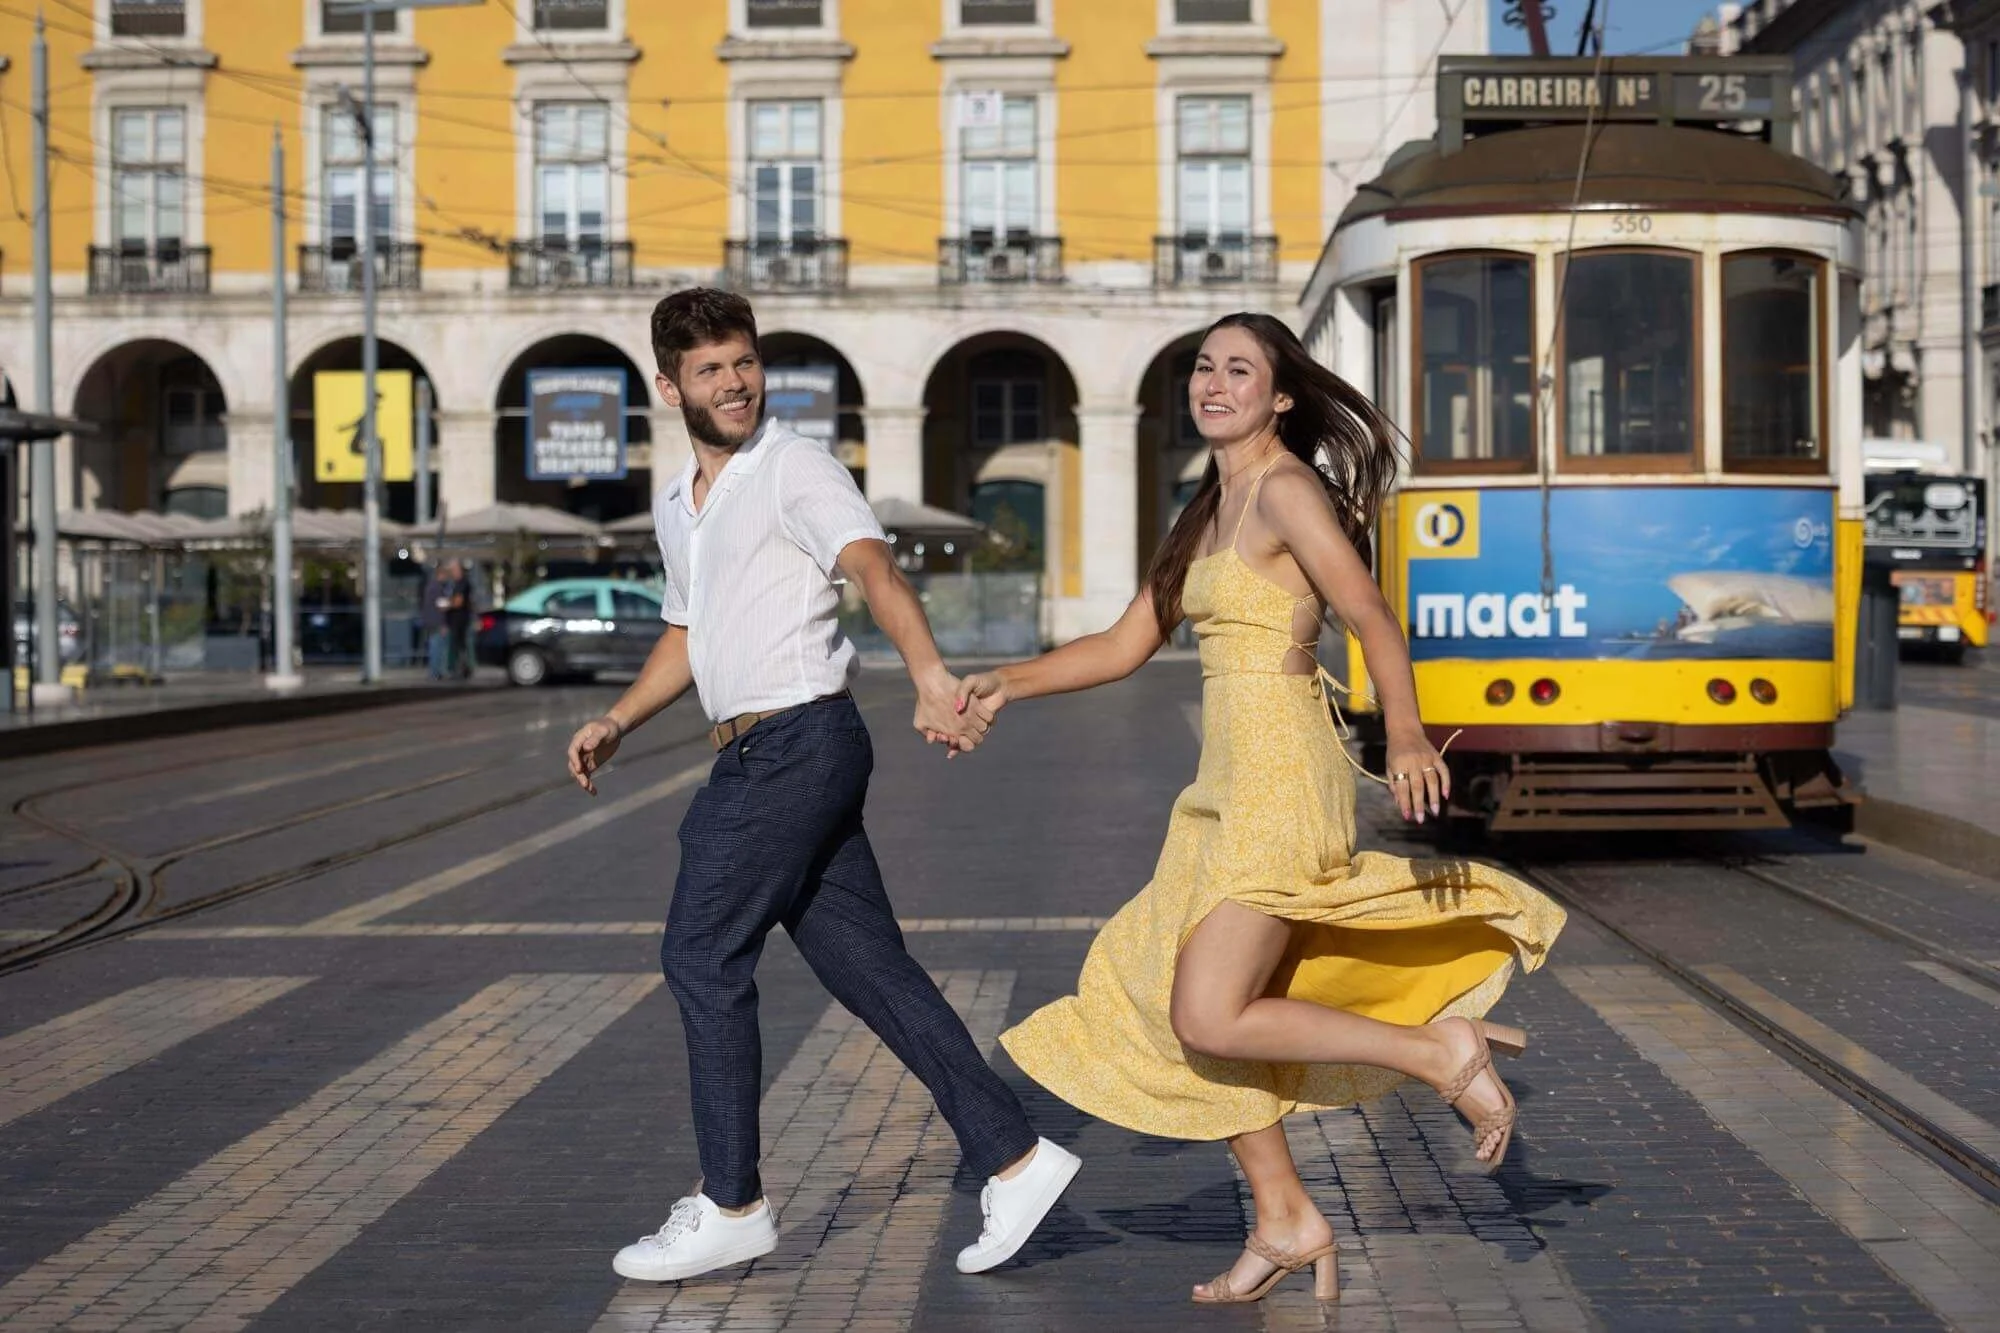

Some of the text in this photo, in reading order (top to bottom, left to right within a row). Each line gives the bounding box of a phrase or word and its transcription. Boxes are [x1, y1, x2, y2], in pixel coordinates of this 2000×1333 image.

[1463, 77, 1601, 107] CARREIRA
[1699, 74, 1747, 111] 25
[1611, 215, 1652, 234] 550
[1416, 583, 1588, 638] maat
